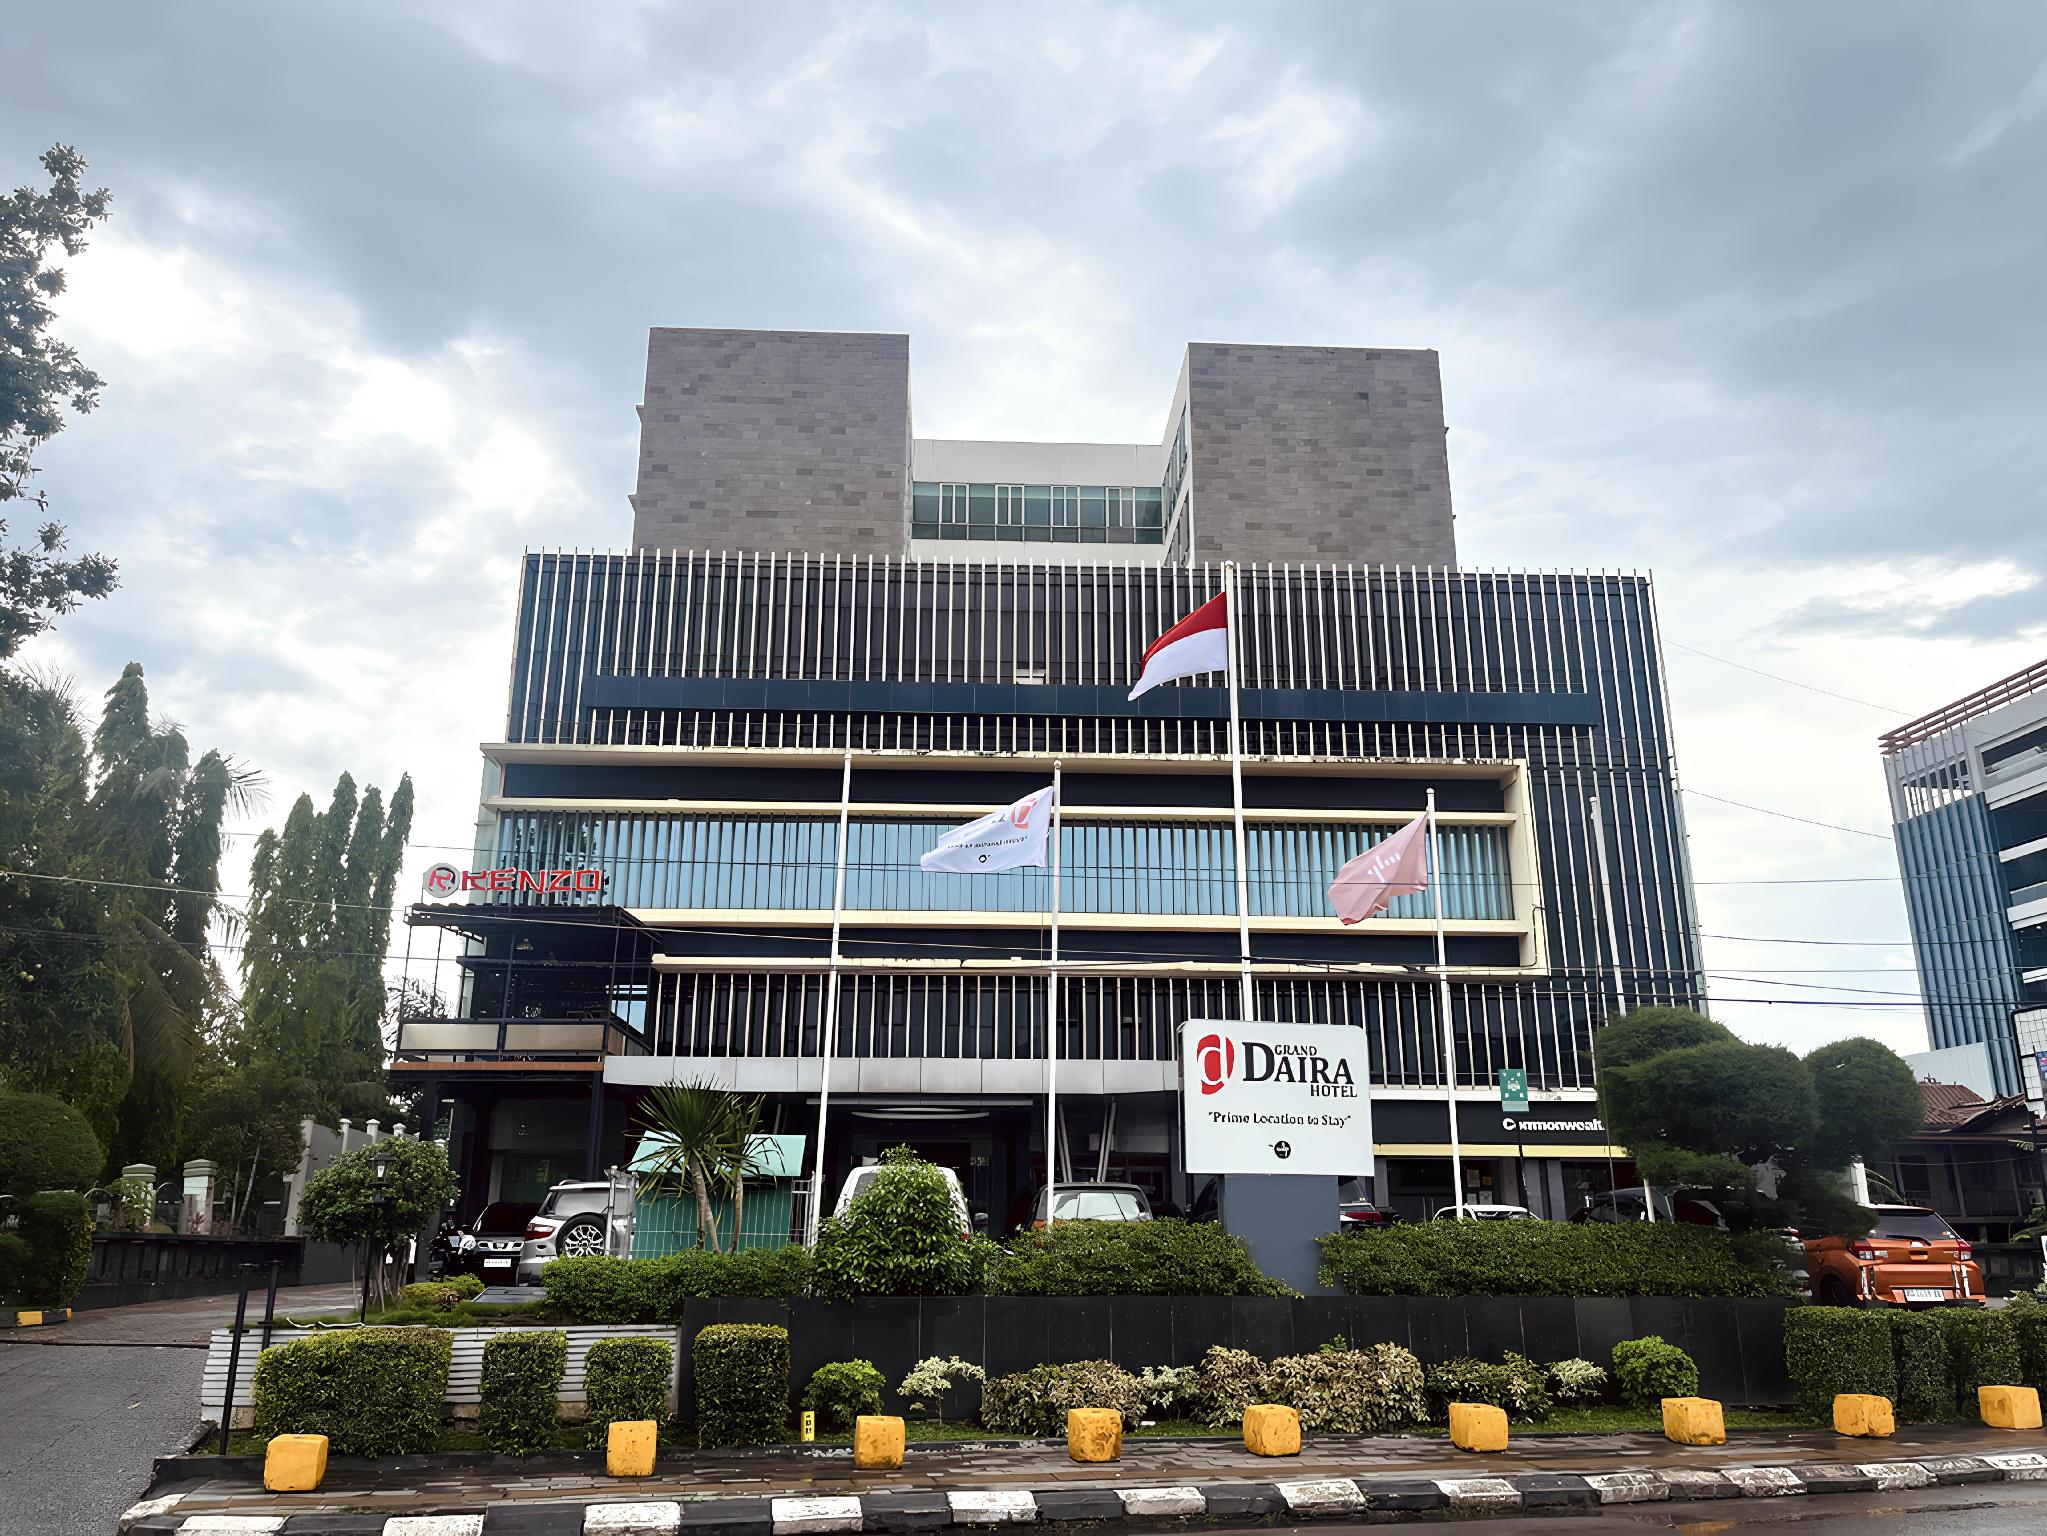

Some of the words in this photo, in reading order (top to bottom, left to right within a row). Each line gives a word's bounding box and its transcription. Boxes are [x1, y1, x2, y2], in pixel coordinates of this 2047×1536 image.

[461, 867, 601, 893] KENZO
[1275, 1044, 1317, 1056] GRAND
[1242, 1041, 1354, 1085] DAIRA
[1310, 1084, 1358, 1097] HOTEL
[1253, 1113, 1304, 1125] Location
[1307, 1115, 1319, 1125] to
